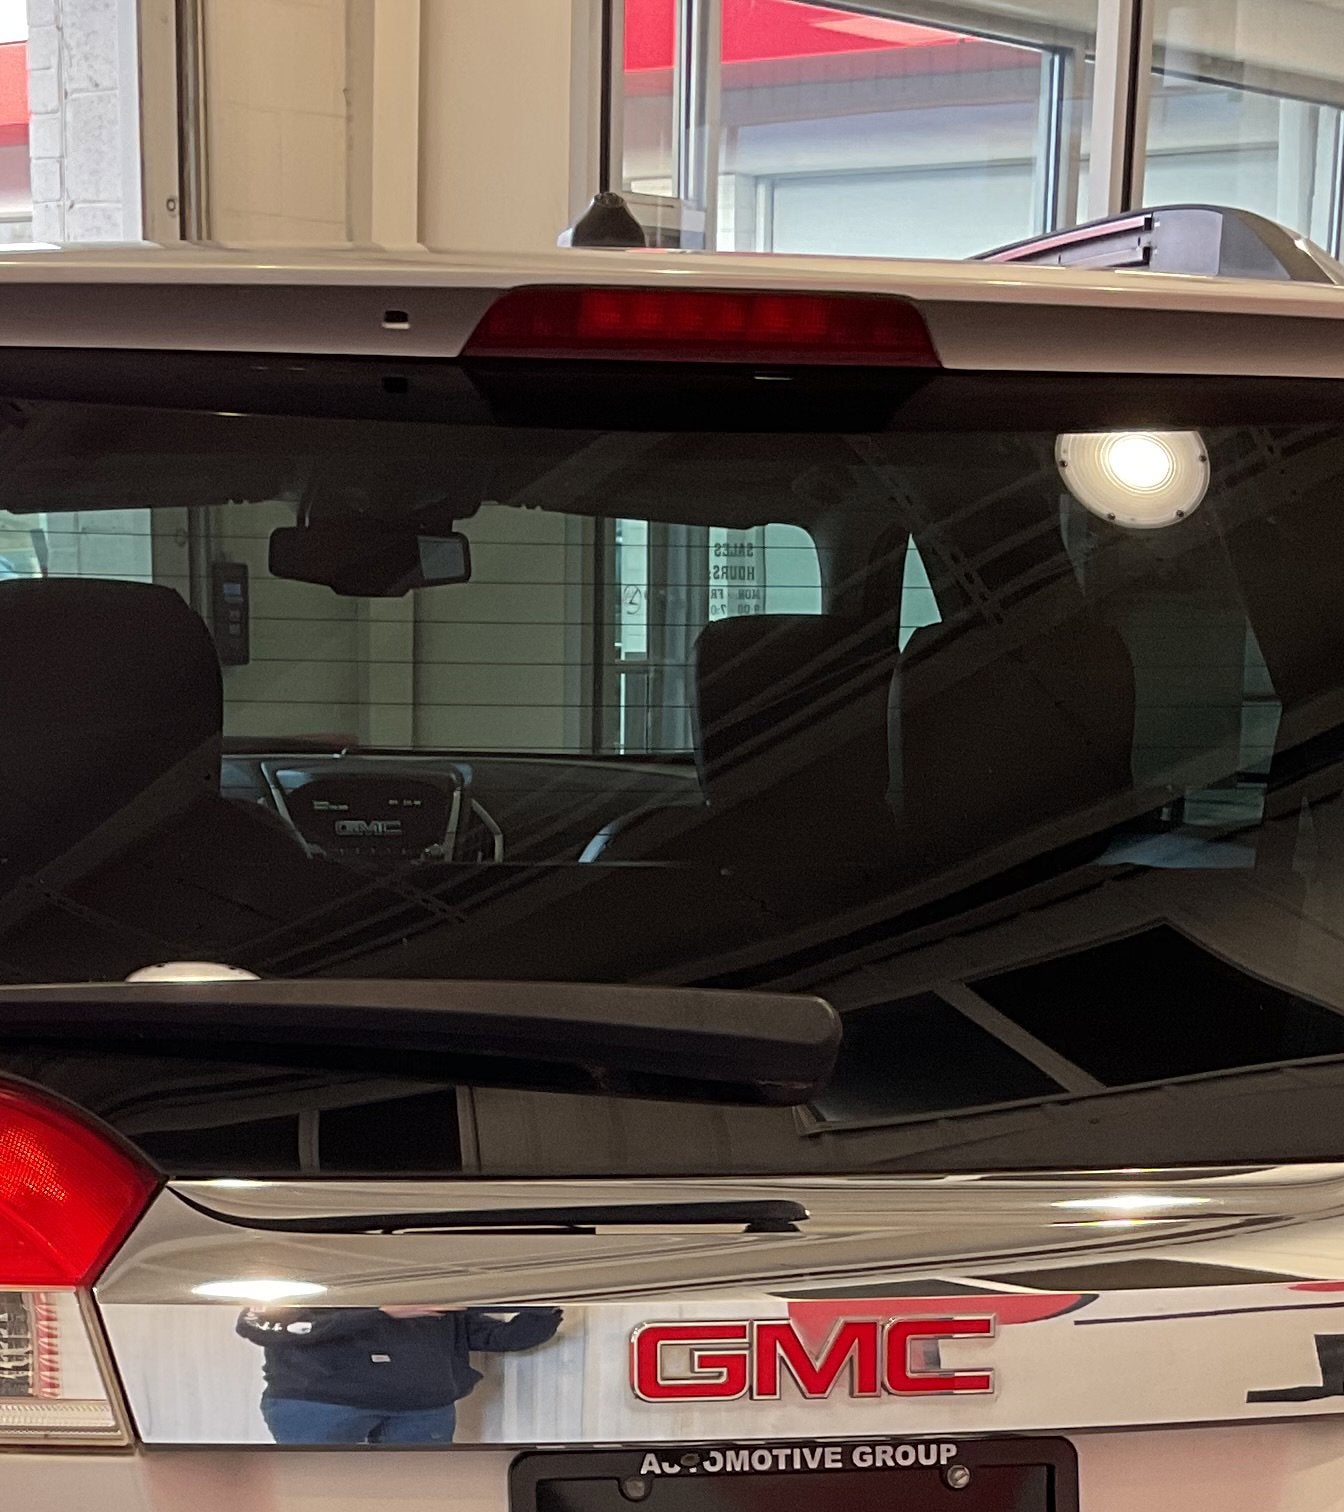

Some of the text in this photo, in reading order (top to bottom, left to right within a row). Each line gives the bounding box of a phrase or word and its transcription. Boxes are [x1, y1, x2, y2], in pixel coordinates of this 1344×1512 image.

[629, 1314, 997, 1403] GMC
[640, 1443, 958, 1475] AOMOTIVE GROUP
